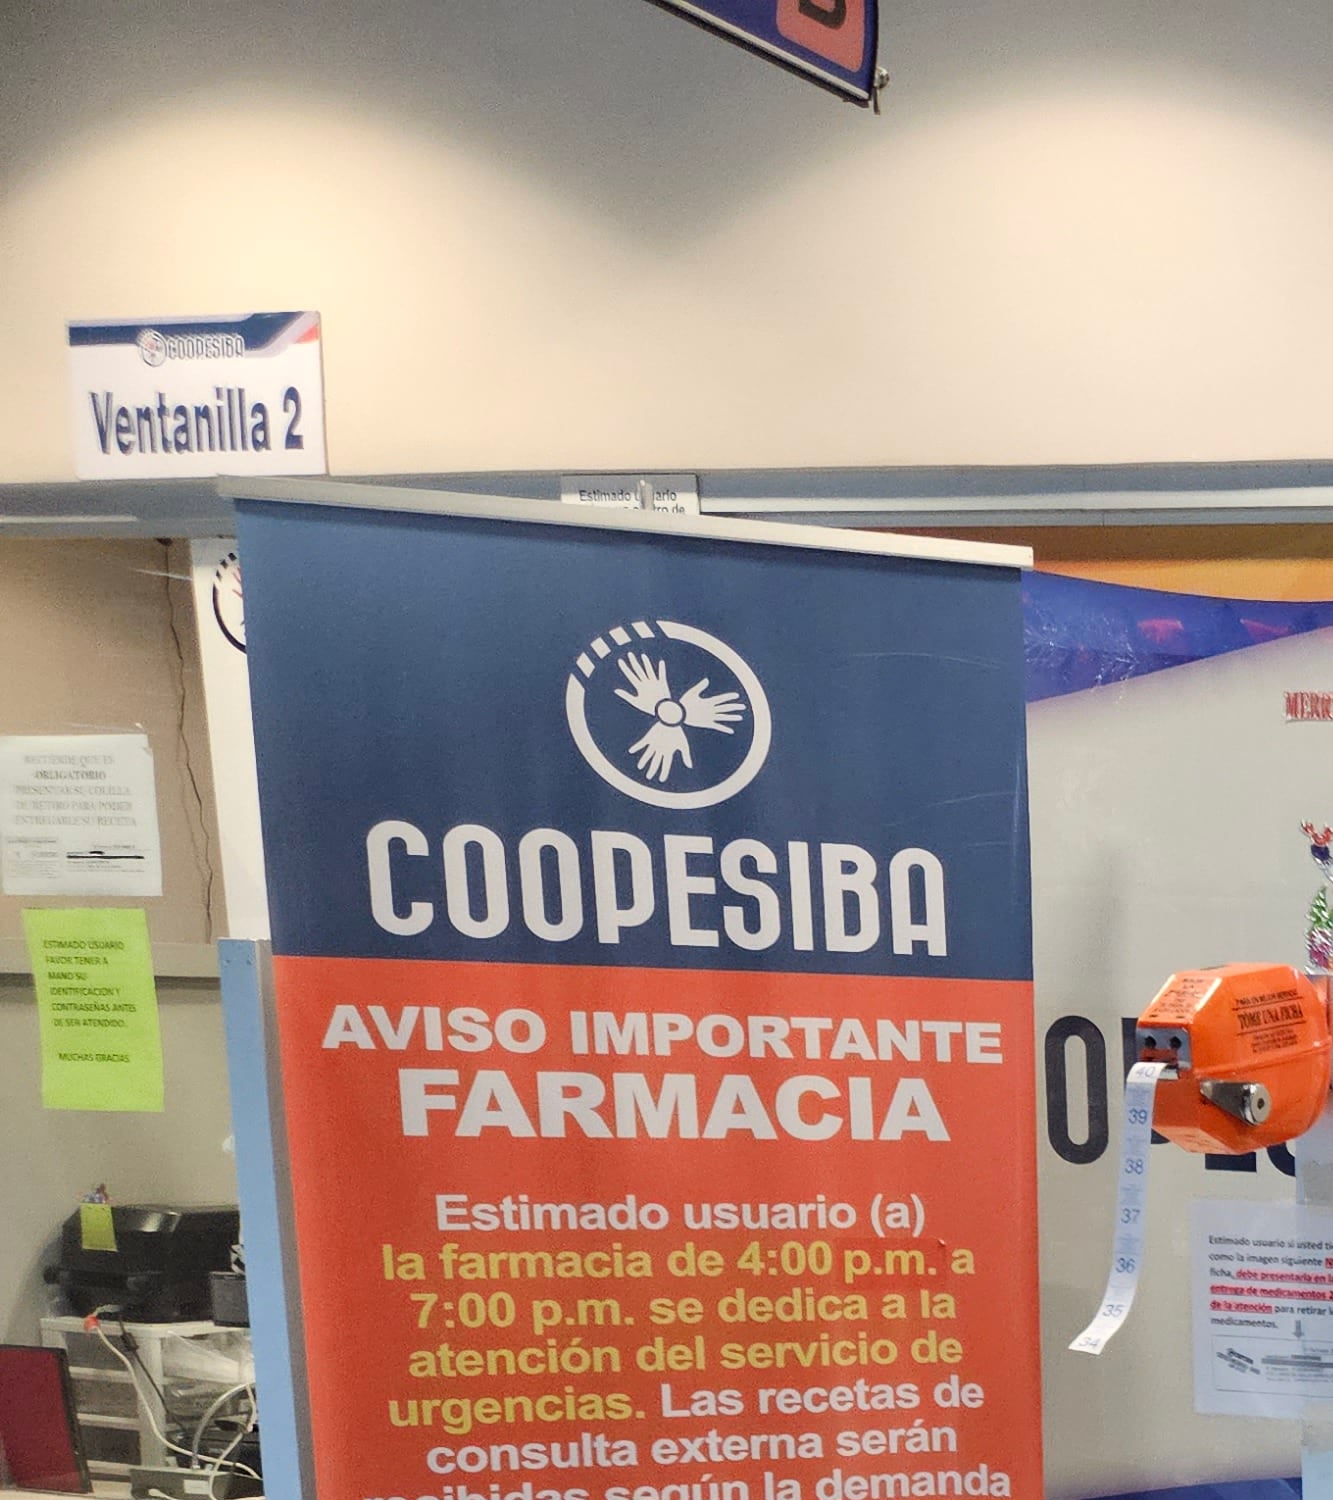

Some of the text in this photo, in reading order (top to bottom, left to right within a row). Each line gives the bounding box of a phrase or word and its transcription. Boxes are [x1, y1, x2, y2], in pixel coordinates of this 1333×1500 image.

[168, 335, 244, 360] COOPESIBA
[89, 386, 304, 454] Ventanilla 2
[366, 820, 948, 957] COOPESIBA
[321, 1004, 1003, 1064] AVISO IMPORTANTE
[399, 1068, 950, 1142] FARMACIA
[1128, 1109, 1148, 1124] 39
[1125, 1159, 1144, 1175] 38
[436, 1194, 925, 1238] Estimado usuario (a)
[1121, 1208, 1141, 1224] 37
[382, 1241, 974, 1283] la farmacia de 4:00 p.m. a
[1116, 1258, 1136, 1274] 36
[410, 1288, 956, 1335] 7:00 p.m. se dedica a la
[1102, 1304, 1123, 1318] 35
[409, 1331, 962, 1378] atención del servicio de
[388, 1375, 984, 1435] urgencias. Las recetas de
[426, 1421, 957, 1474] consulta externa serán
